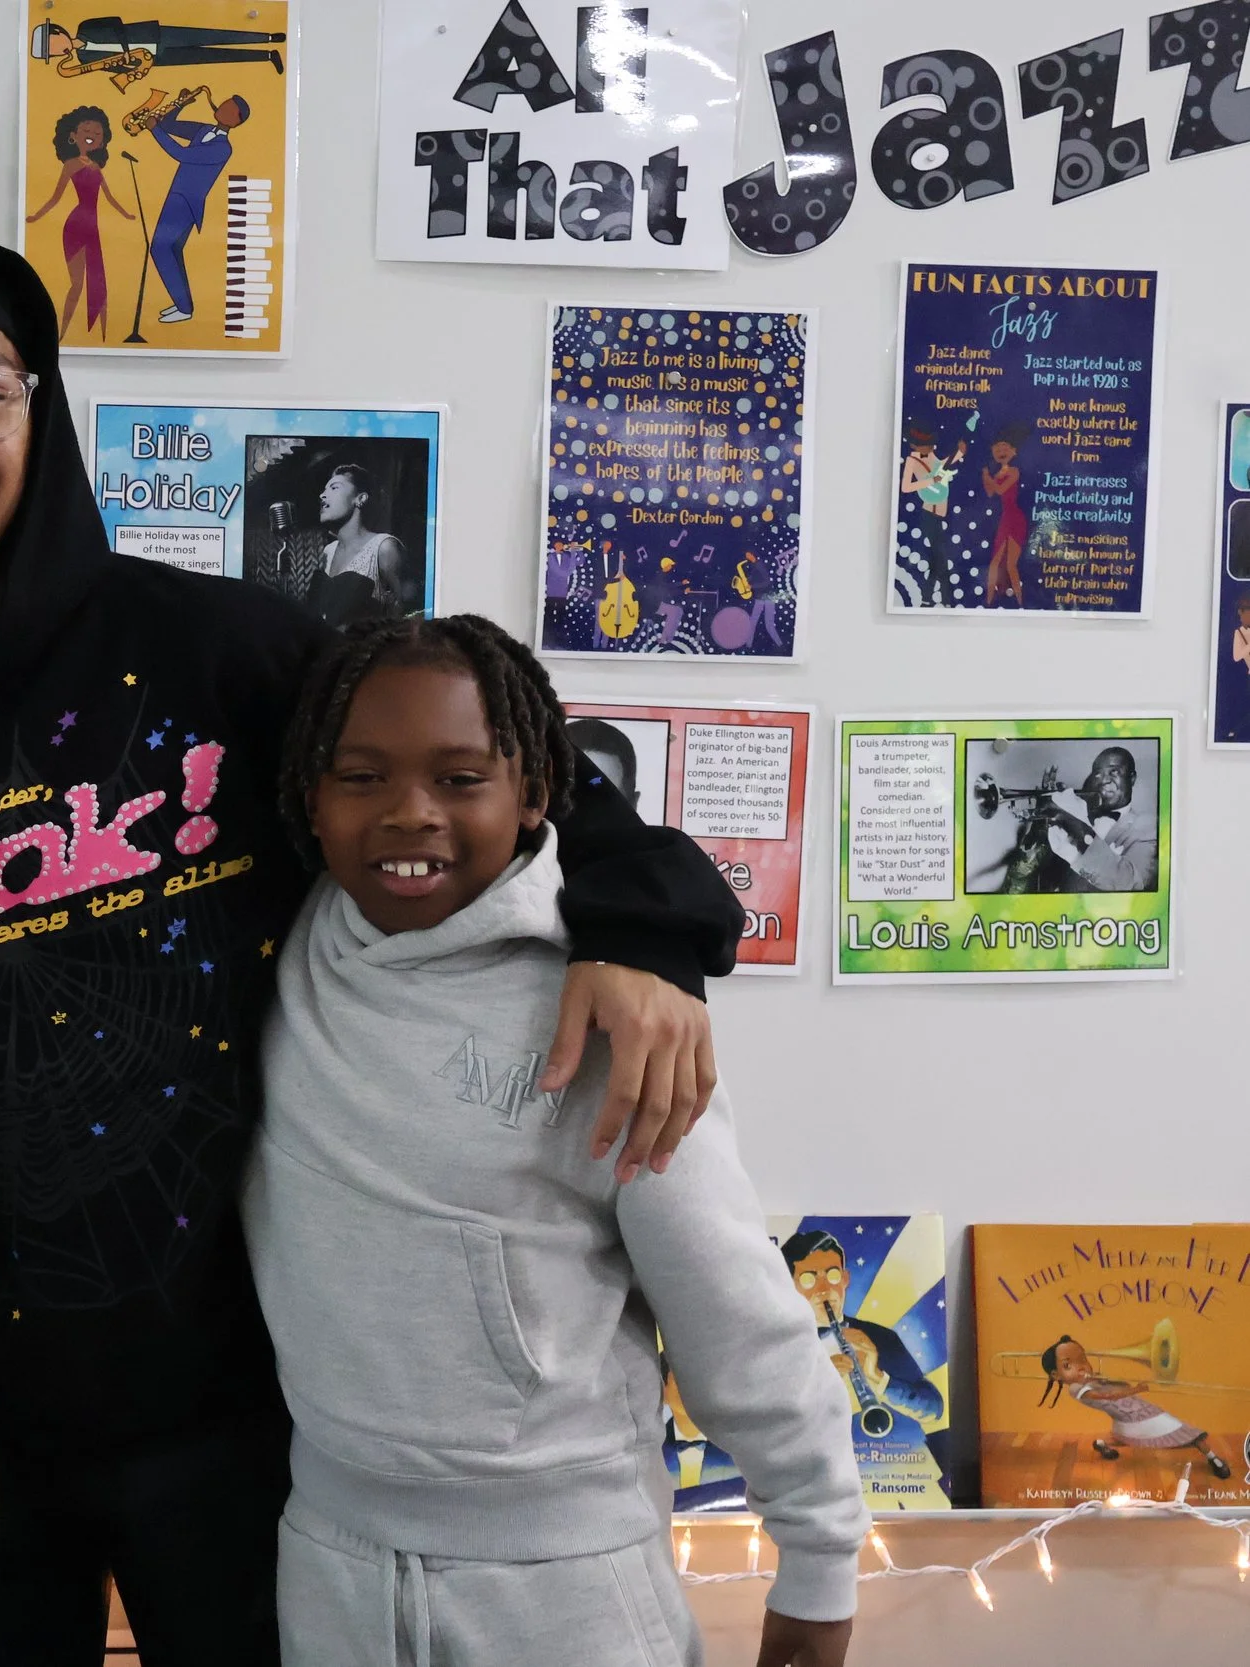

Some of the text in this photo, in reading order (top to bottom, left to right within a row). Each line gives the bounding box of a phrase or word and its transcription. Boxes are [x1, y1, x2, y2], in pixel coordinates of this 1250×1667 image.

[721, 0, 1250, 257] Jazz
[415, 128, 690, 247] That
[914, 272, 1152, 299] FUN FACTS ABOUT
[989, 295, 1058, 349] Jazz
[599, 348, 759, 372] Jazz to me is a living
[928, 344, 990, 360] Jazz dance
[914, 362, 1003, 376] originated from
[690, 378, 700, 391] a
[704, 376, 748, 392] music
[925, 378, 990, 392] African folk
[626, 394, 730, 414] that since its
[626, 417, 727, 438] beginning has
[131, 423, 212, 463] Billie
[673, 441, 699, 460] the
[646, 464, 663, 481] of
[667, 463, 692, 481] the
[100, 472, 242, 521] Holiday
[626, 507, 723, 525] -Dexter Gordon
[119, 530, 142, 539] Billie
[144, 531, 179, 541] Holiday
[202, 533, 220, 541] one
[142, 544, 196, 554] of the most
[187, 561, 220, 570] singers
[689, 727, 713, 737] Duke
[715, 728, 755, 740] Ellington
[688, 743, 788, 754] originator of big-band
[855, 739, 879, 747] Louis
[881, 739, 929, 748] Armstrong
[881, 753, 929, 761] trumpeter,
[858, 765, 945, 774] bandleader, soloist,
[873, 779, 891, 787] film
[912, 779, 930, 787] and
[877, 792, 924, 801] comedian.
[86, 888, 145, 918] the
[162, 854, 254, 897] slime
[847, 913, 1161, 955] Louis Armstrong
[872, 1482, 926, 1494] Ransome
